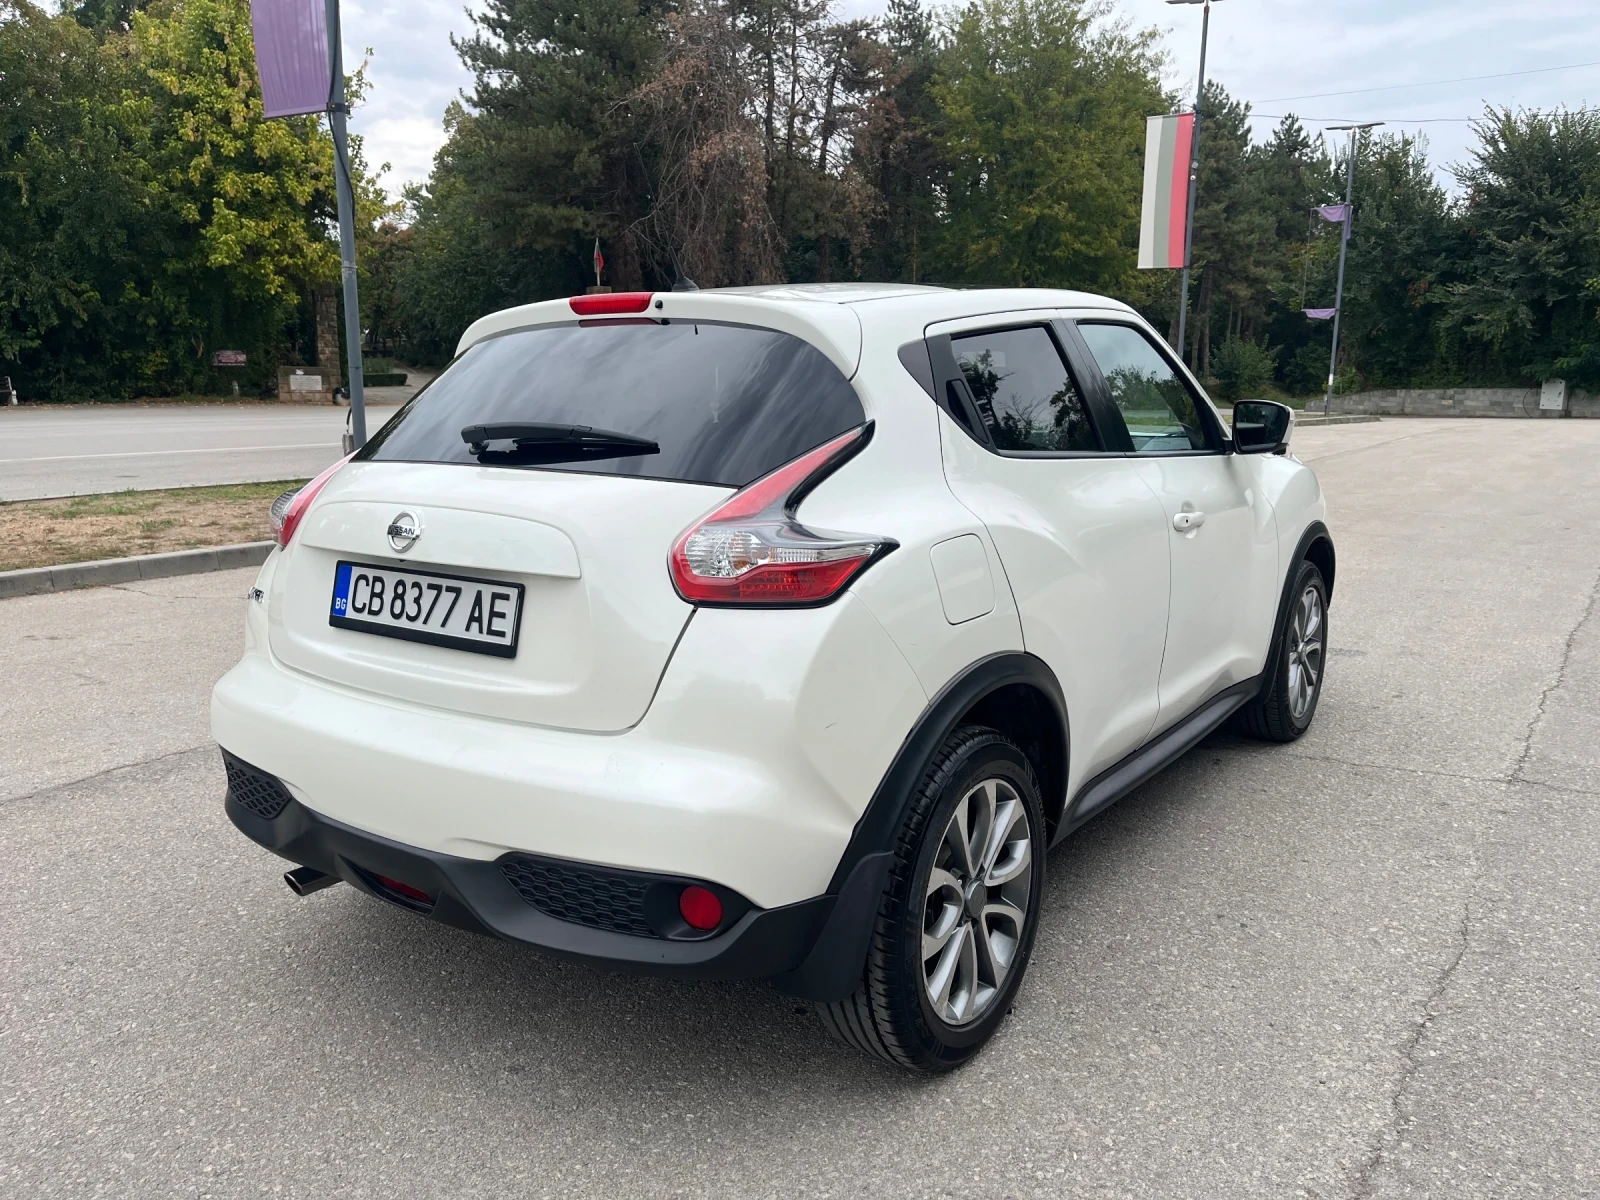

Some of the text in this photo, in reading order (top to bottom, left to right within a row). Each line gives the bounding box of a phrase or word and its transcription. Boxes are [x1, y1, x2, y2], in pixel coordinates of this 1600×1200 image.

[335, 598, 346, 610] BG
[351, 574, 510, 638] CB 8377 AE
